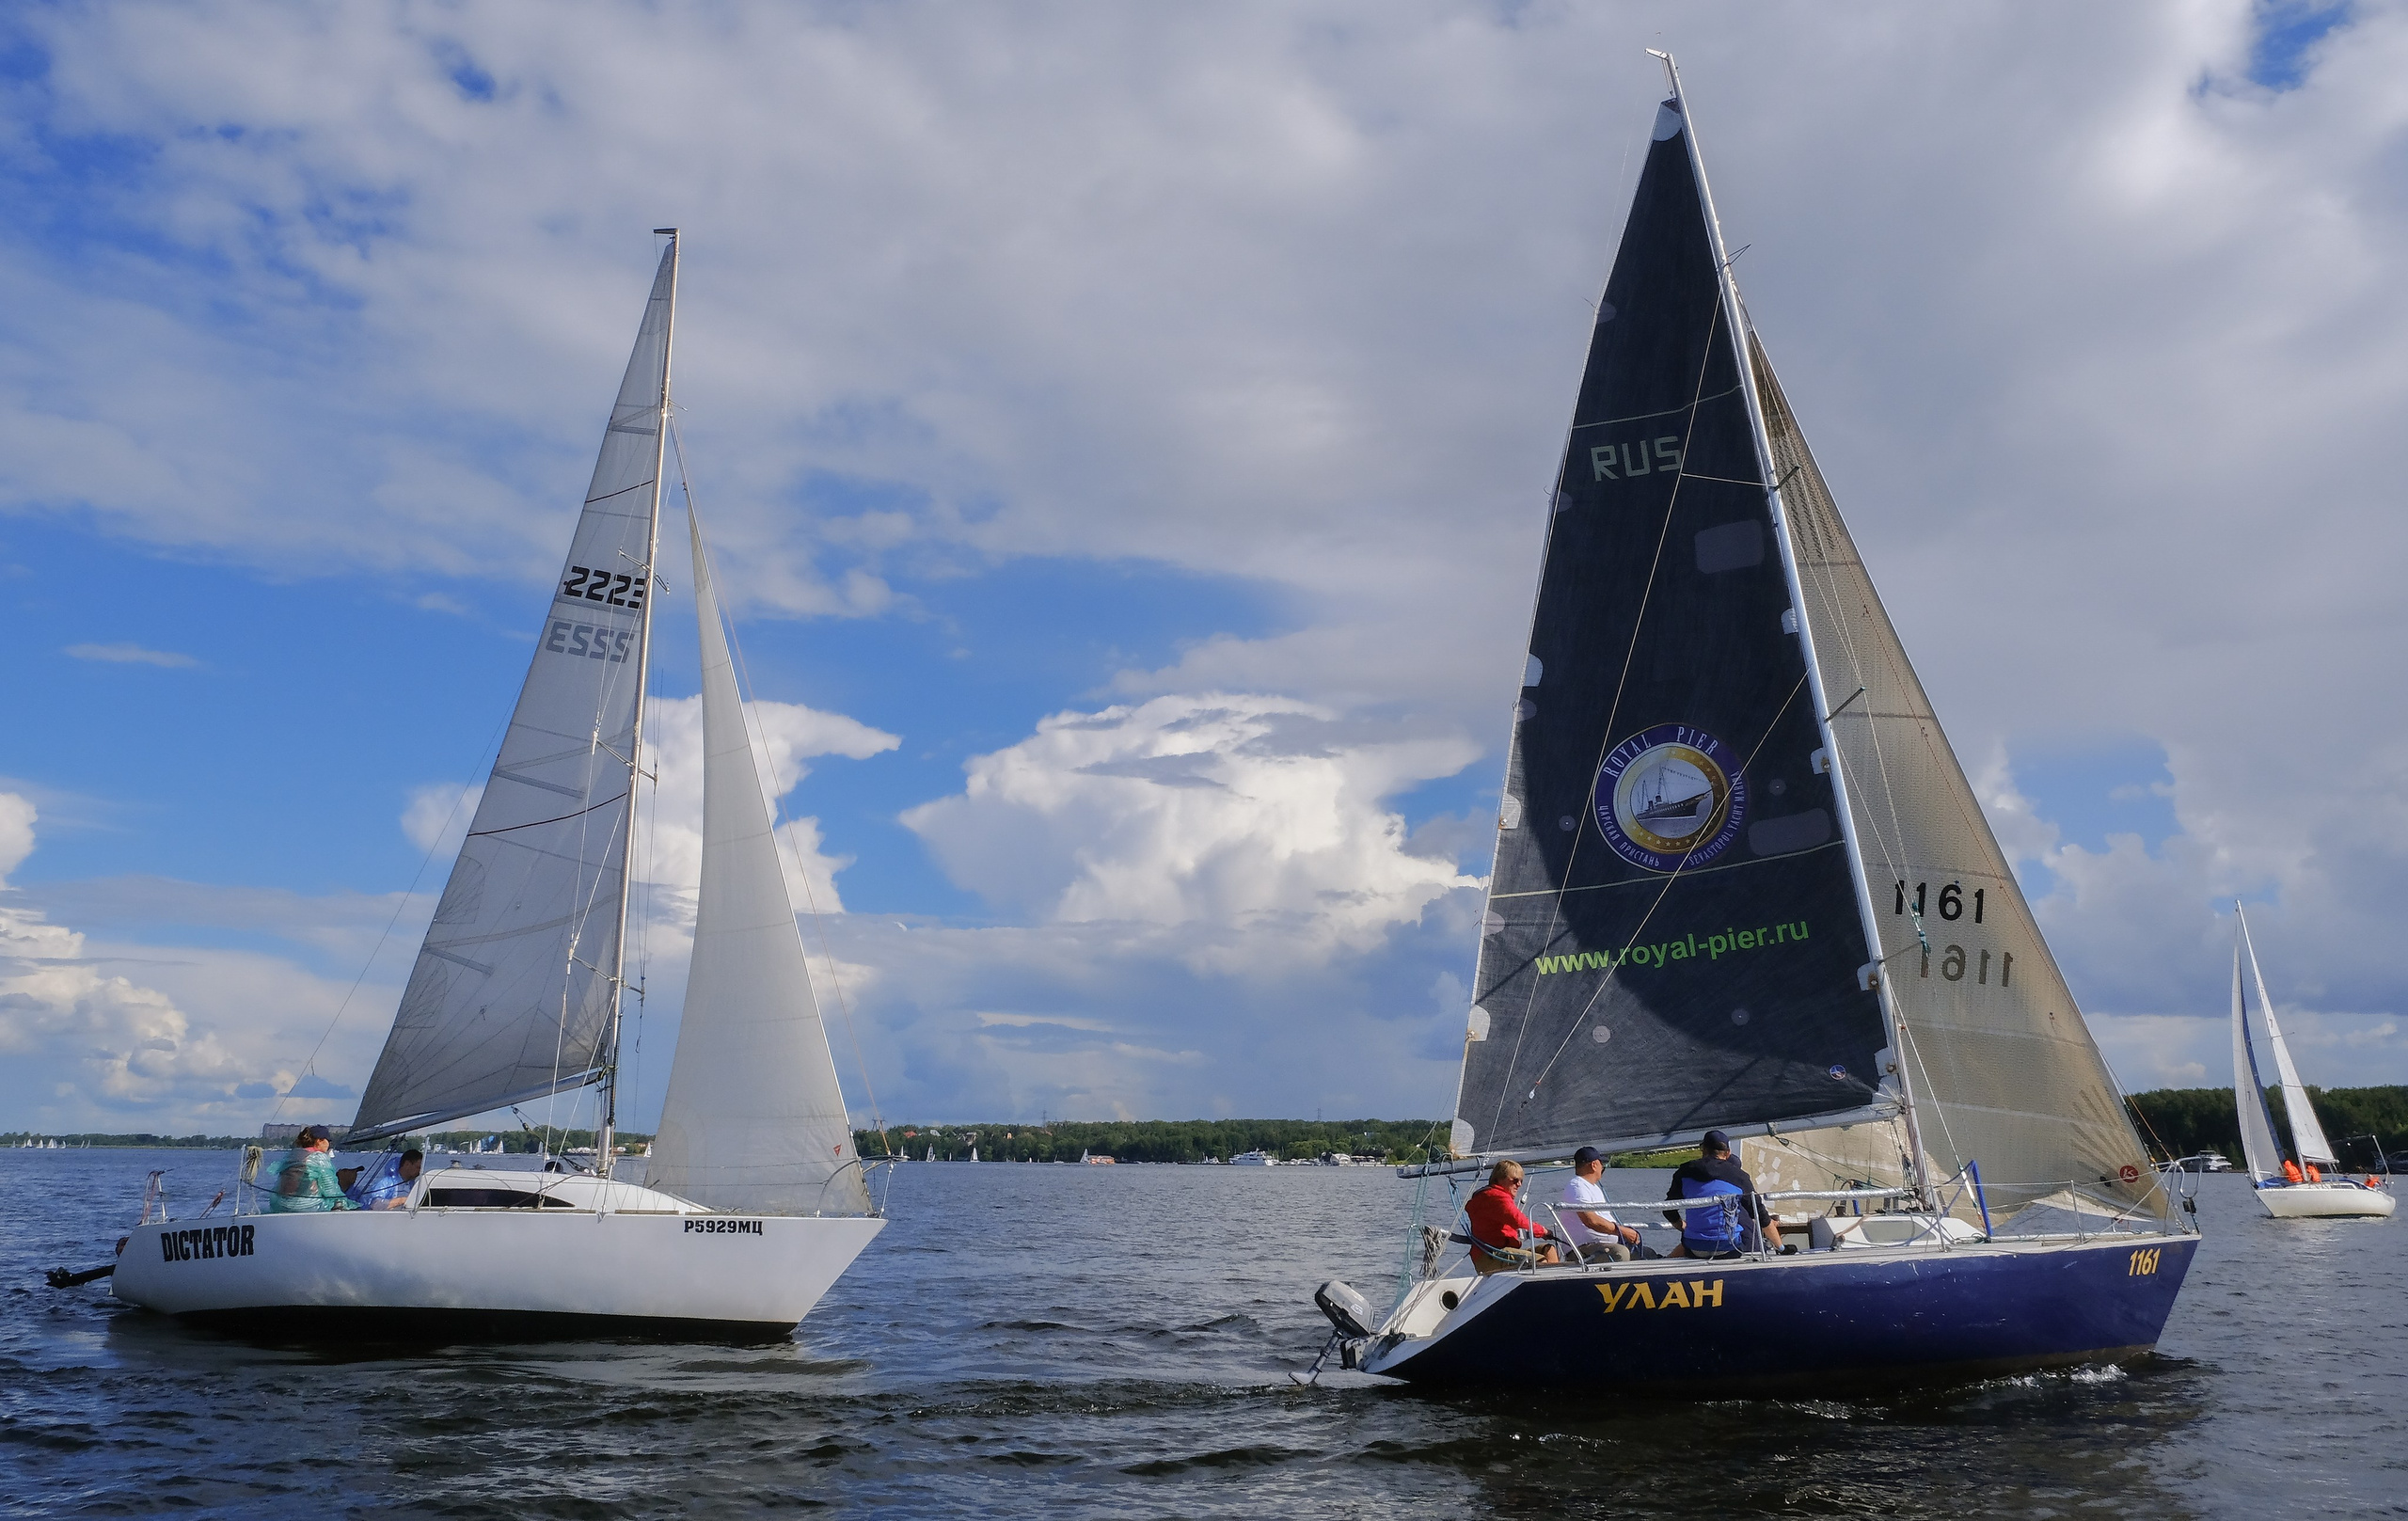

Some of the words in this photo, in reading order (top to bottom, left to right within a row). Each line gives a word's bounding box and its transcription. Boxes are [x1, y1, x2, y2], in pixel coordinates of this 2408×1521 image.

[1591, 436, 1682, 482] RUS
[1603, 734, 1652, 778] ROYAL
[1676, 726, 1719, 755] PIER
[1598, 805, 1621, 841] ЦАРСКАЯ
[1619, 841, 1660, 867] ПРИСТАНЬ
[1688, 832, 1734, 866] SEVASTOPOL
[1727, 804, 1744, 831] YACHT
[1894, 879, 1985, 924] 1161
[1534, 920, 1810, 975] www.royal-pier.ru
[161, 1225, 255, 1262] DICTATOR
[684, 1219, 763, 1236] Р5929МЦ
[2128, 1247, 2162, 1276] 1161
[1594, 1279, 1724, 1314] УЛАН
